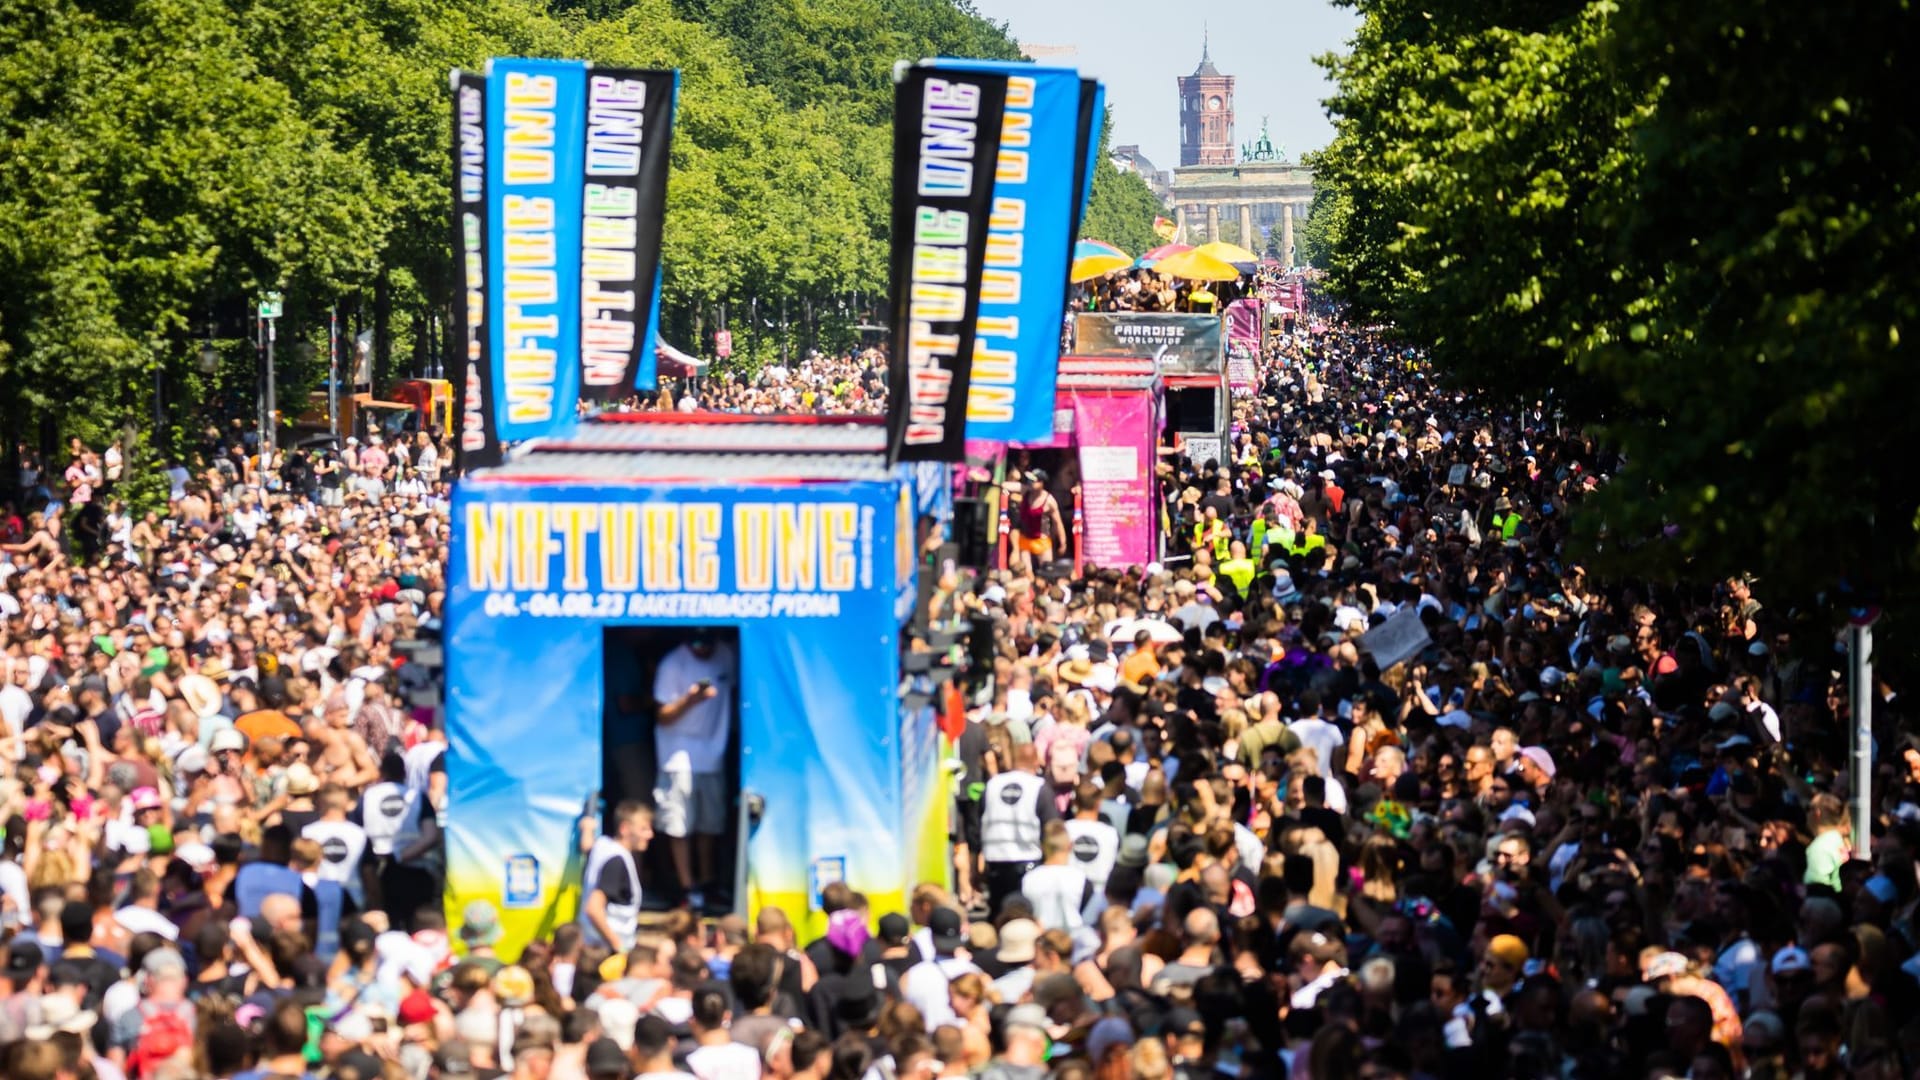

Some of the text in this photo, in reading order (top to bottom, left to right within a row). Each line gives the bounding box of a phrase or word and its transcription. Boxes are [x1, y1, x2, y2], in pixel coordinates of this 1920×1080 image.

[503, 71, 557, 185] ONE
[584, 75, 646, 178] ONE
[917, 77, 981, 198] ONE
[1114, 325, 1185, 337] PARADISE
[465, 502, 722, 593] NATURE
[733, 502, 859, 593] ONE
[627, 593, 772, 618] RAKETENBASIS
[772, 594, 840, 618] PYDNA
